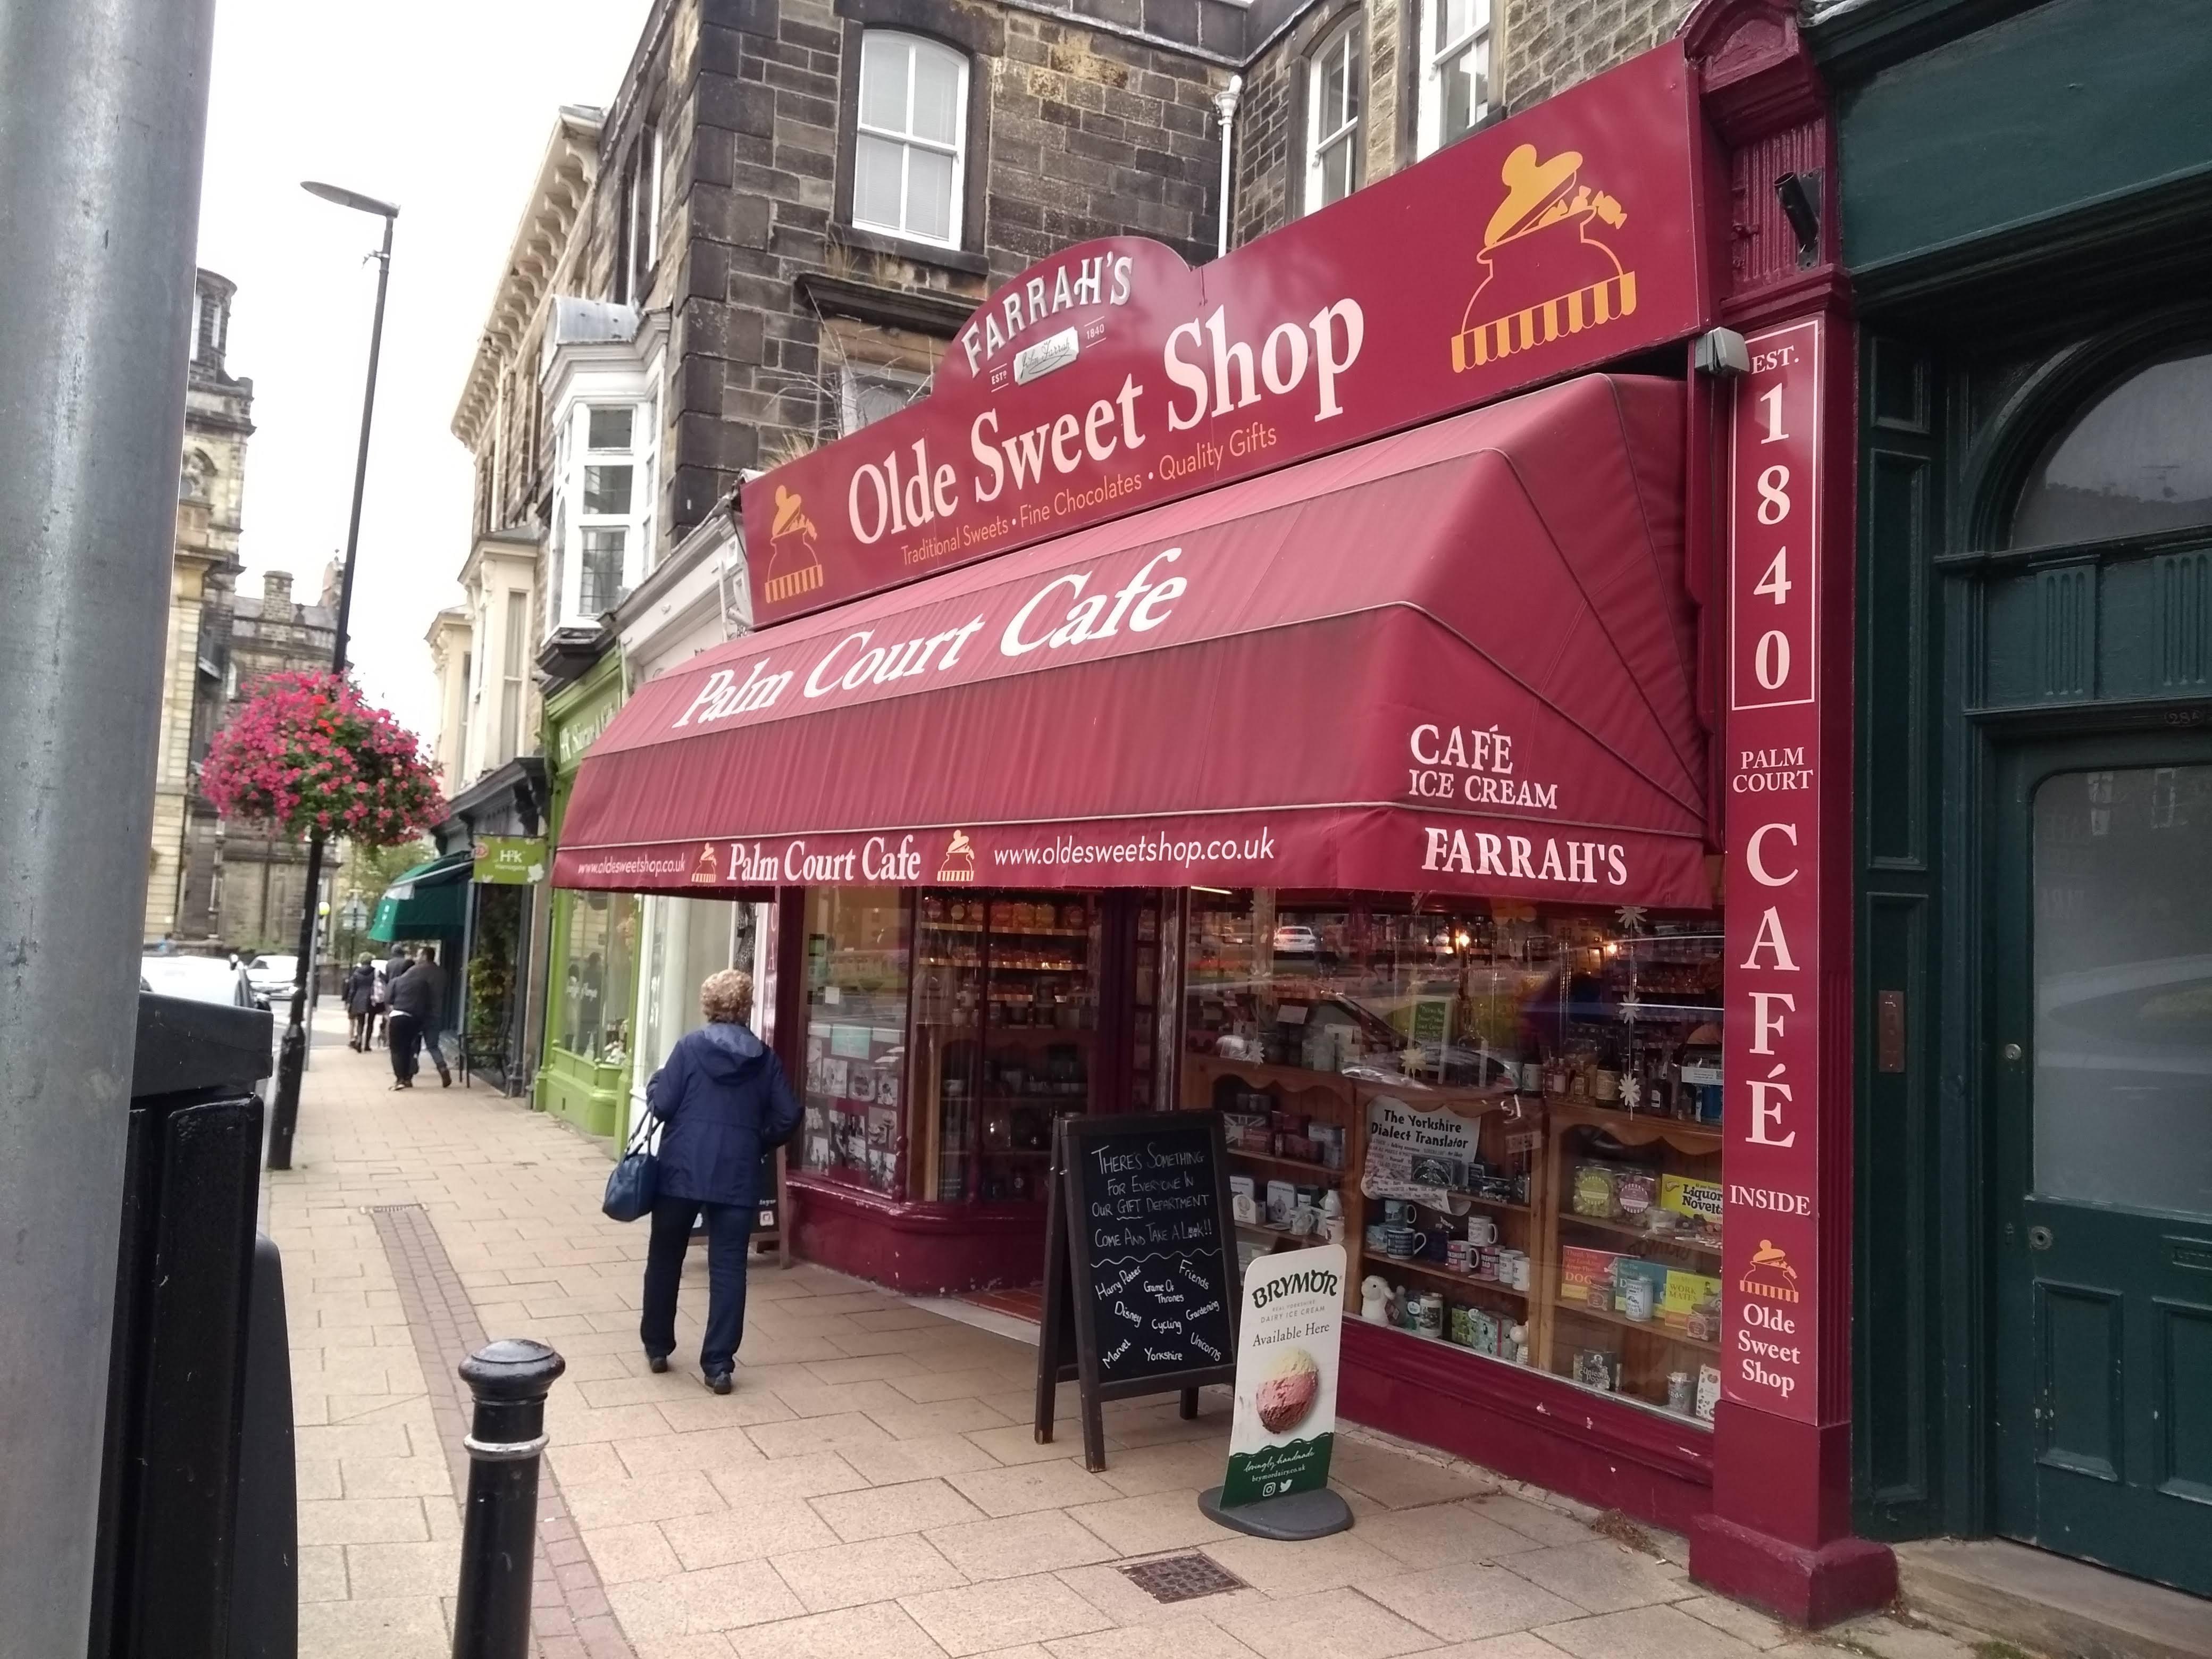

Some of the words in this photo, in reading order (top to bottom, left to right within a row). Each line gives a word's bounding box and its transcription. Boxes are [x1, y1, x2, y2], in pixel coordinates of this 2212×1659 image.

[961, 251, 1134, 379] FARRAH'S
[1086, 323, 1105, 340] 1840
[1752, 345, 1799, 375] EST.
[849, 437, 958, 544] Olde
[970, 373, 1146, 504] Sweet
[1164, 297, 1365, 432] Shop
[901, 533, 960, 566] Traditional
[963, 515, 1009, 547] Sweets
[1020, 504, 1050, 528] Fine
[1054, 472, 1142, 516] Chocolates
[1159, 442, 1224, 481] Quality
[1229, 422, 1277, 458] Gifts
[1753, 382, 1792, 690] 1840
[672, 657, 793, 728] Palm
[803, 613, 986, 698] Court
[1000, 547, 1187, 657] Cafe
[1410, 724, 1513, 775] CAFÉ
[1740, 747, 1805, 770] PALM
[1409, 769, 1454, 799] ICE
[1464, 775, 1558, 809] CREAM
[1732, 769, 1814, 793] COURT
[726, 843, 779, 882] Palm
[784, 840, 855, 880] Court
[862, 834, 921, 881] Cafe
[994, 826, 1275, 868] www.oldesweetshop.co.uk
[1421, 827, 1628, 886] FARRAH'S
[578, 853, 686, 876] www.oldesweetshop.co.uk
[1371, 1121, 1411, 1141] Dialect
[1415, 1130, 1469, 1149] Translator
[1384, 1109, 1404, 1124] The
[1407, 1114, 1462, 1133] Yorkshire
[1146, 1142, 1204, 1168] SOMETHING
[1107, 1178, 1126, 1196] FOR
[1132, 1174, 1182, 1194] EVERYONE
[1185, 1171, 1194, 1187] IN
[1092, 1201, 1113, 1217] OUR
[1117, 1198, 1141, 1214] GIFT
[1146, 1194, 1210, 1212] DEPARTMENT
[1730, 1185, 1811, 1216] INSIDE
[1094, 1228, 1121, 1249] COME
[1125, 1229, 1146, 1246] AND
[1146, 1221, 1169, 1242] TAKE
[1171, 1227, 1179, 1242] A
[1095, 1277, 1122, 1300] Harry
[1120, 1265, 1142, 1286] Potter
[1143, 1281, 1163, 1293] Game
[1178, 1259, 1210, 1289] Friends
[1155, 1293, 1184, 1305] Thrones
[1252, 1269, 1338, 1309] BRYMOR
[1669, 1291, 1698, 1302] MATES
[1670, 1283, 1697, 1295] WORK
[1114, 1301, 1142, 1328] Disney
[1185, 1301, 1220, 1321] Gardening
[1261, 1313, 1284, 1323] DAIRY
[1286, 1310, 1297, 1319] ICE
[1300, 1305, 1326, 1316] CREAM
[1744, 1303, 1795, 1334] Olde
[1151, 1317, 1183, 1335] Cycling
[1253, 1324, 1302, 1347] Available
[1305, 1322, 1330, 1337] Here
[1102, 1339, 1132, 1370] Marvel
[1144, 1347, 1183, 1362] Yorkshire
[1189, 1332, 1222, 1362] Unicorns
[1738, 1329, 1801, 1364] Sweet
[1742, 1359, 1796, 1399] Shop
[1244, 1455, 1276, 1472] lovingly
[1276, 1447, 1315, 1465] handmade
[1252, 1463, 1306, 1482] brymordairy.co.uk
